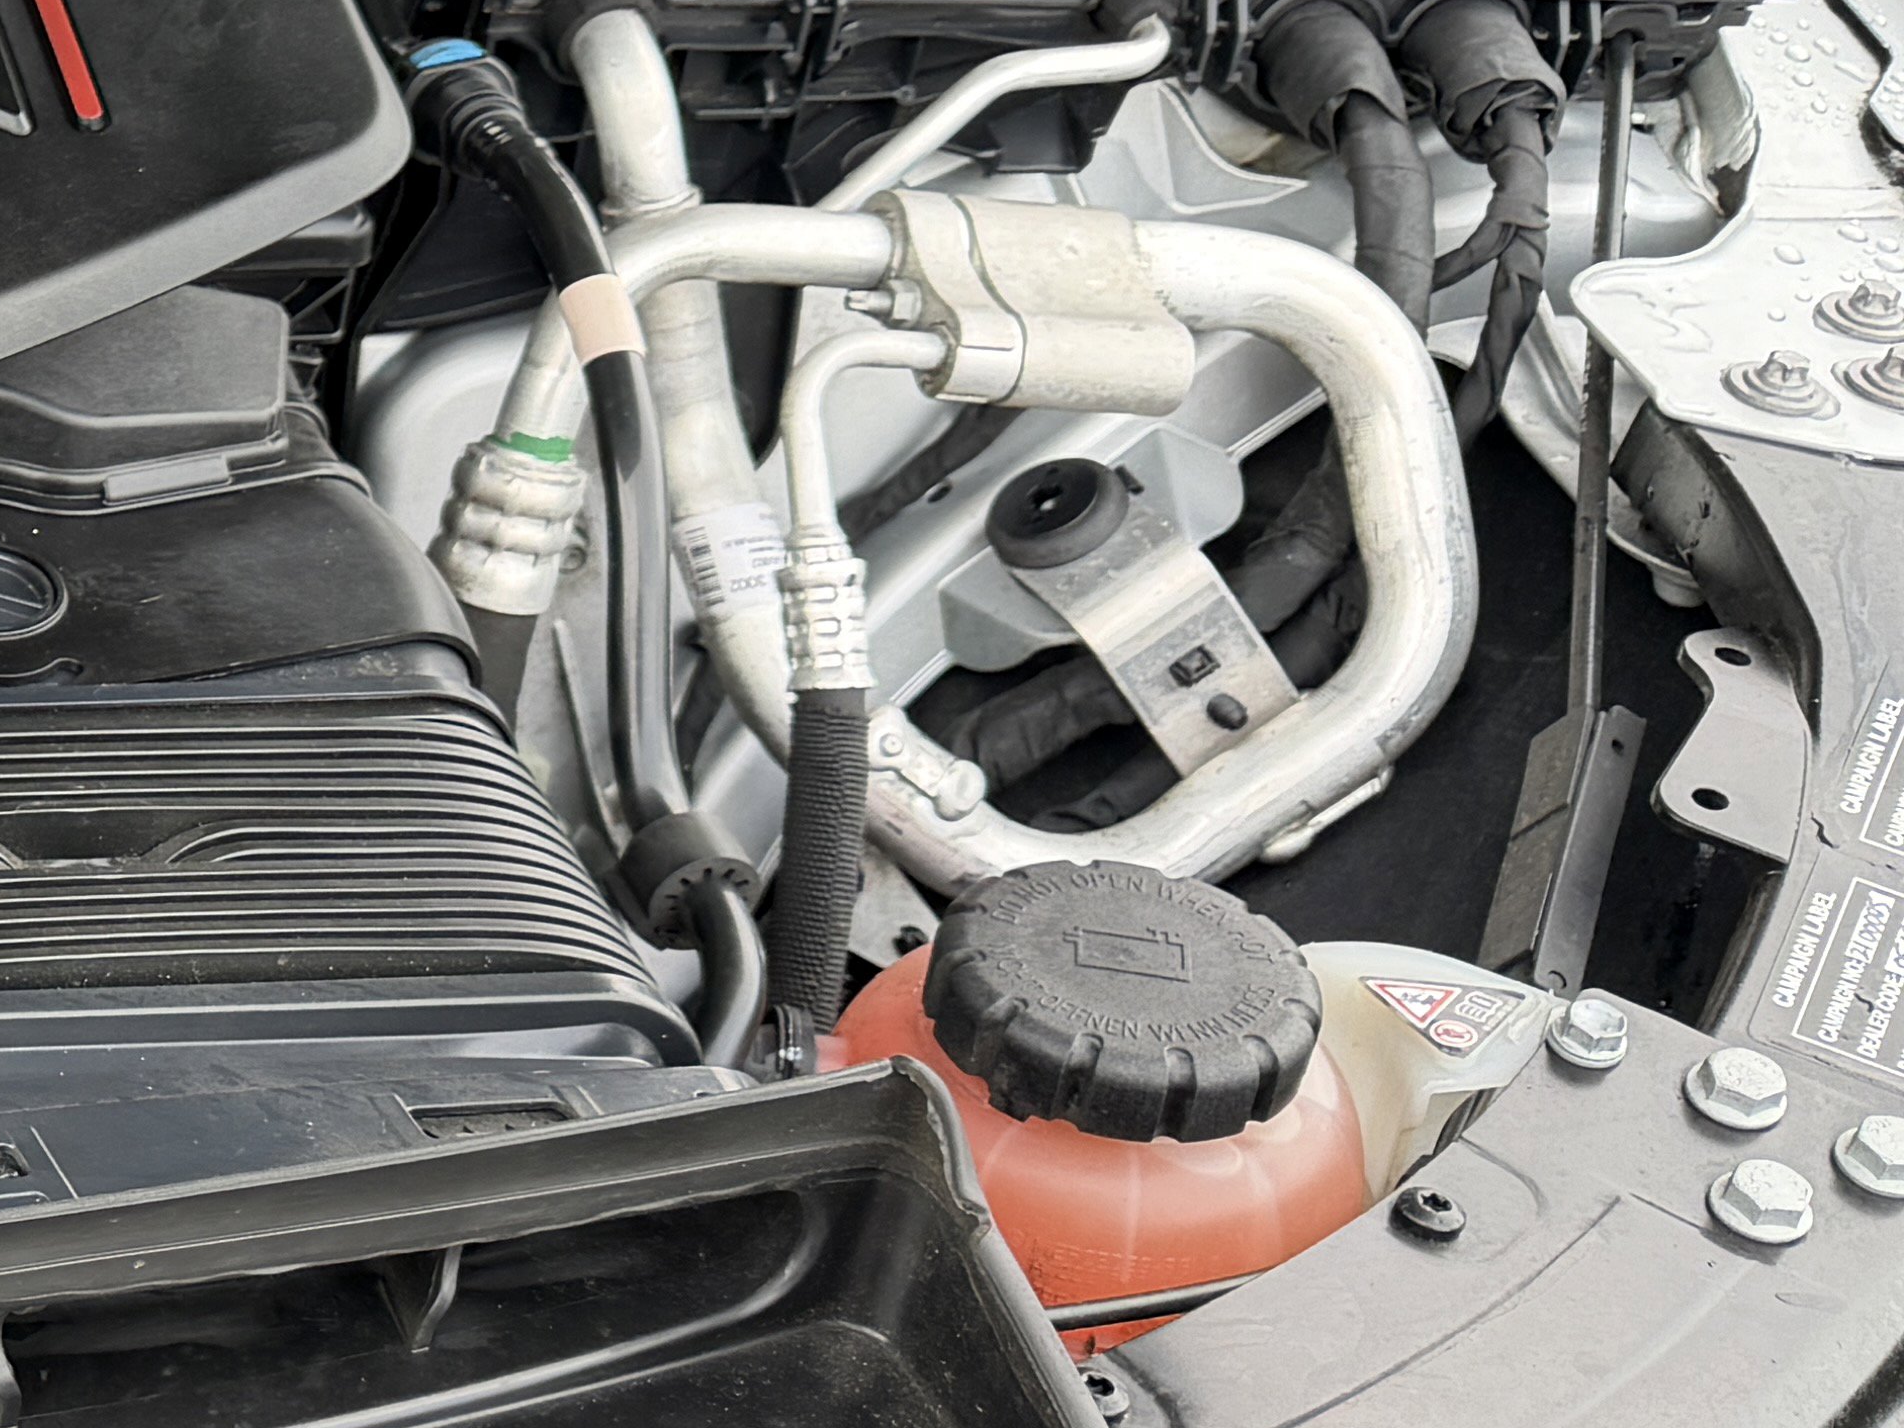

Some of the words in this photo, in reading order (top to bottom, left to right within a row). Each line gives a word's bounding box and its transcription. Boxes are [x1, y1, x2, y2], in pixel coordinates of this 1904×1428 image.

[1840, 739, 1886, 814] CAMPAIGN
[1867, 697, 1904, 744] LABEL
[1069, 873, 1144, 892] OPEN
[1772, 931, 1821, 1009] CAMPAIGN
[1805, 891, 1837, 936] LABEL
[1817, 979, 1859, 1043] CAMPAIGN
[1856, 1008, 1892, 1059] DEALER
